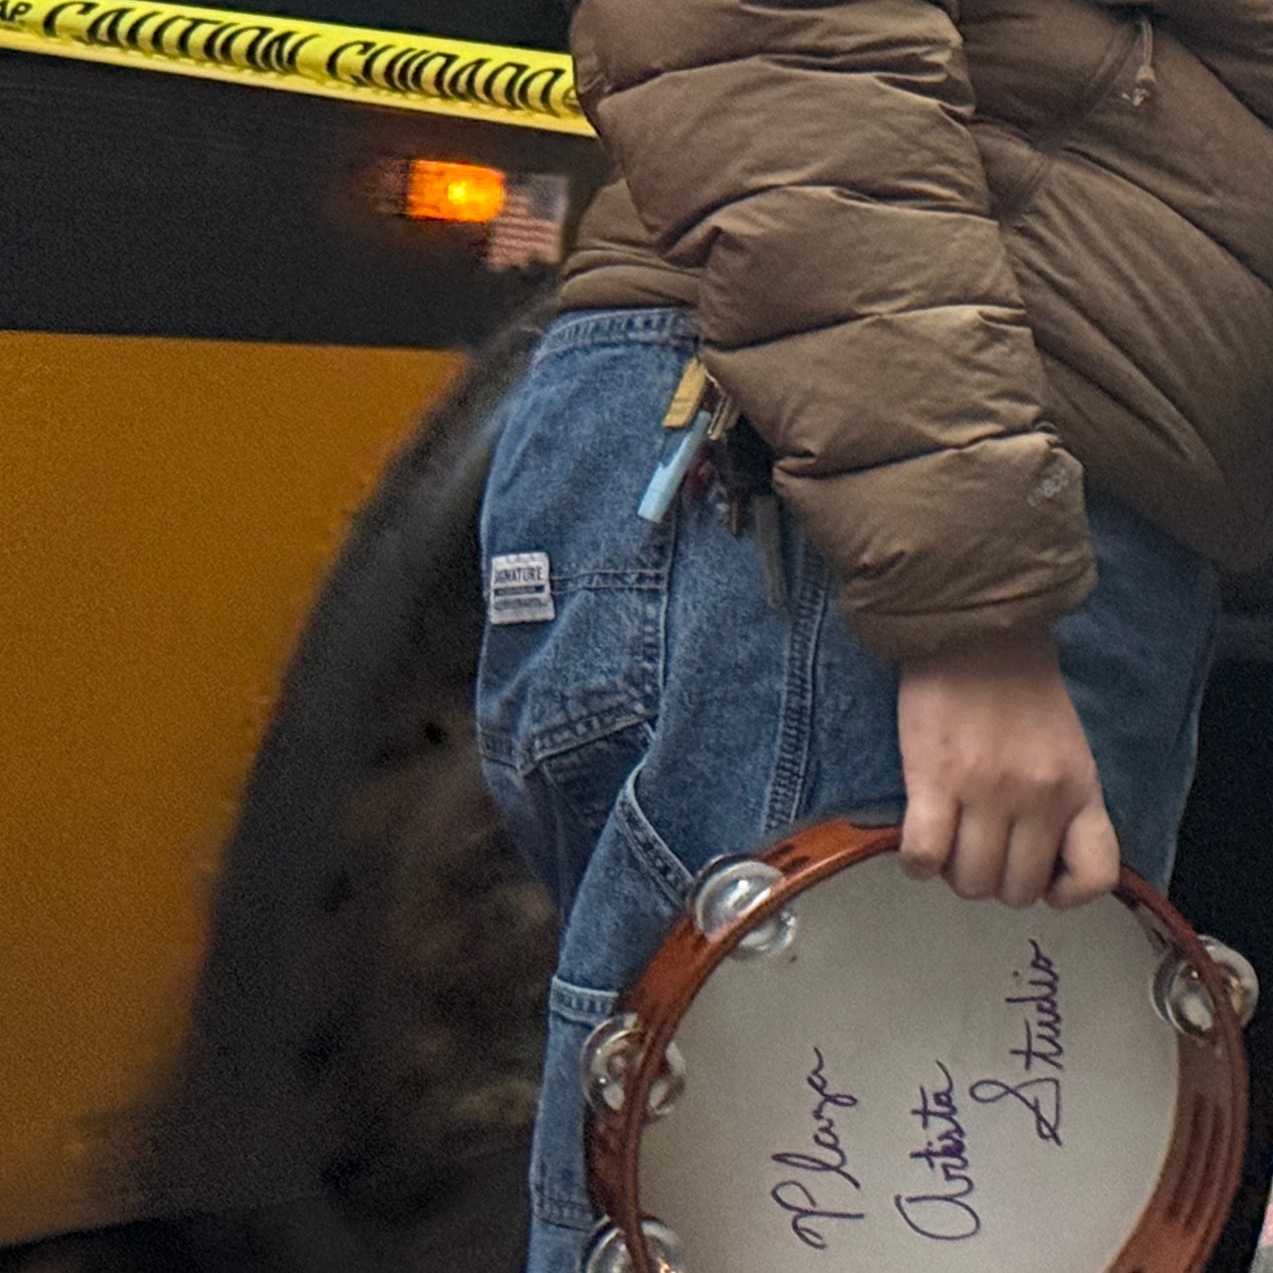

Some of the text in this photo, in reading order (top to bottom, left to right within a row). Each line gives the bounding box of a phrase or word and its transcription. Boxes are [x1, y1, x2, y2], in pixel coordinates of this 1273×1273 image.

[43, 0, 322, 74] CAUTION
[325, 40, 566, 117] CUIDADO
[968, 937, 1065, 1147] Studio
[770, 1046, 865, 1250] Plaza
